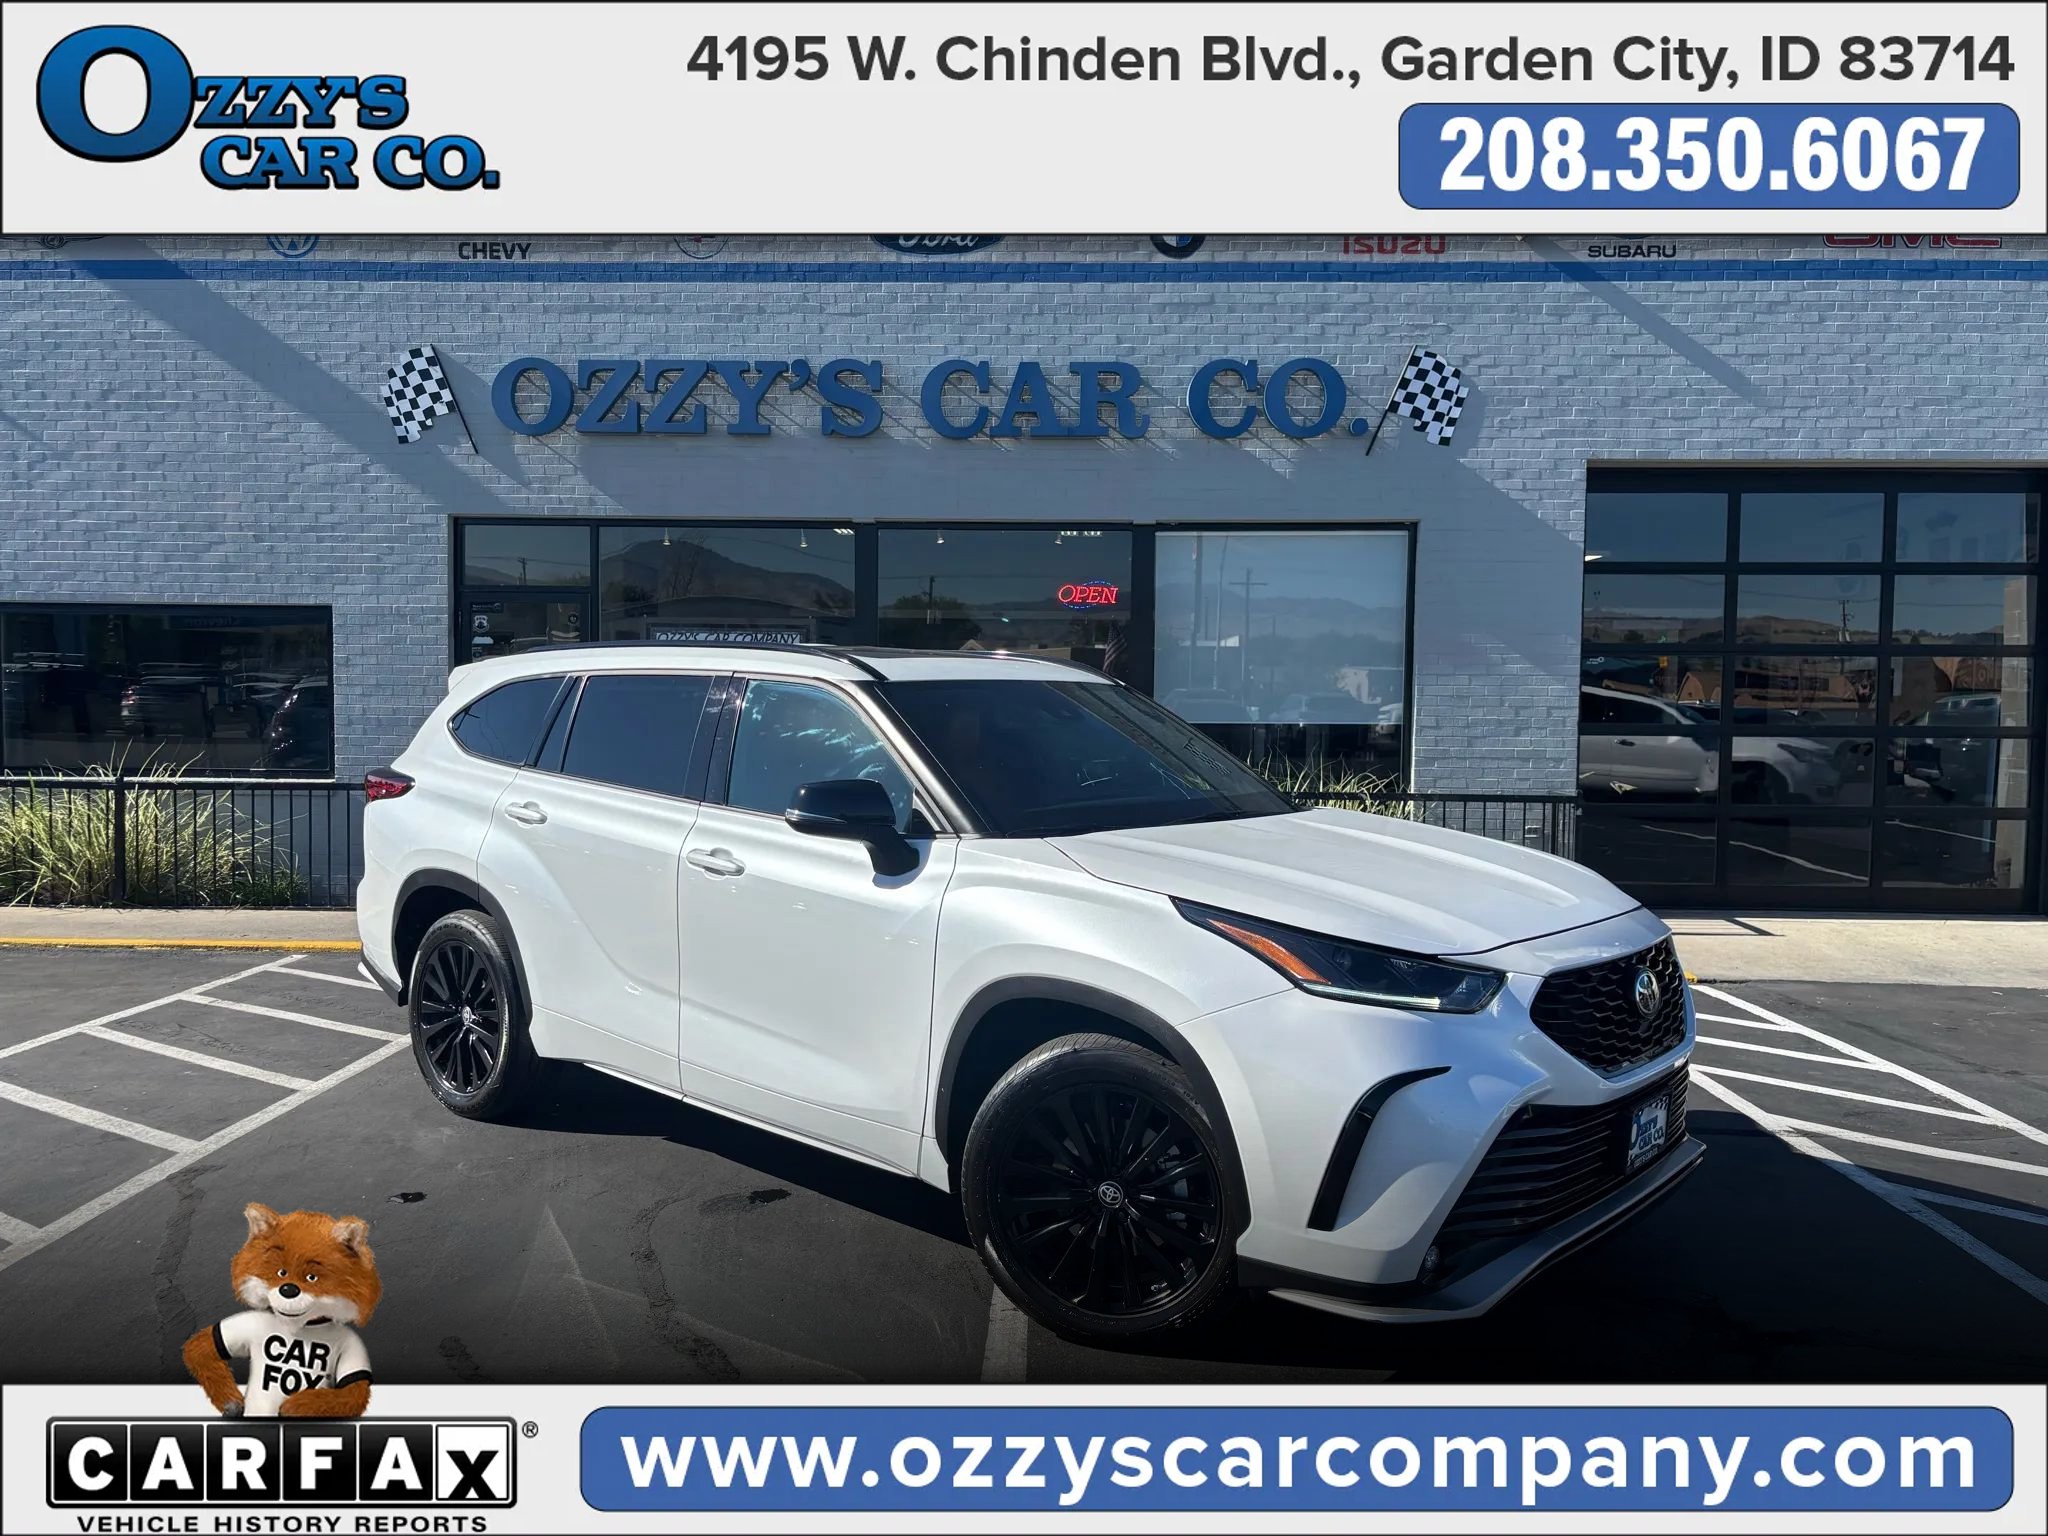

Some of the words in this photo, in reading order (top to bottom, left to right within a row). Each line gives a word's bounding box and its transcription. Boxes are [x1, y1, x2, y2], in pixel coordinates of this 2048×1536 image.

[458, 241, 532, 260] CHEVY
[1343, 234, 1446, 255] ISUZU
[1588, 245, 1677, 258] SUBARU
[491, 356, 884, 435] OZZY'S
[921, 358, 1150, 438] CAR
[1187, 357, 1369, 438] CO.
[1058, 584, 1119, 604] OPEN
